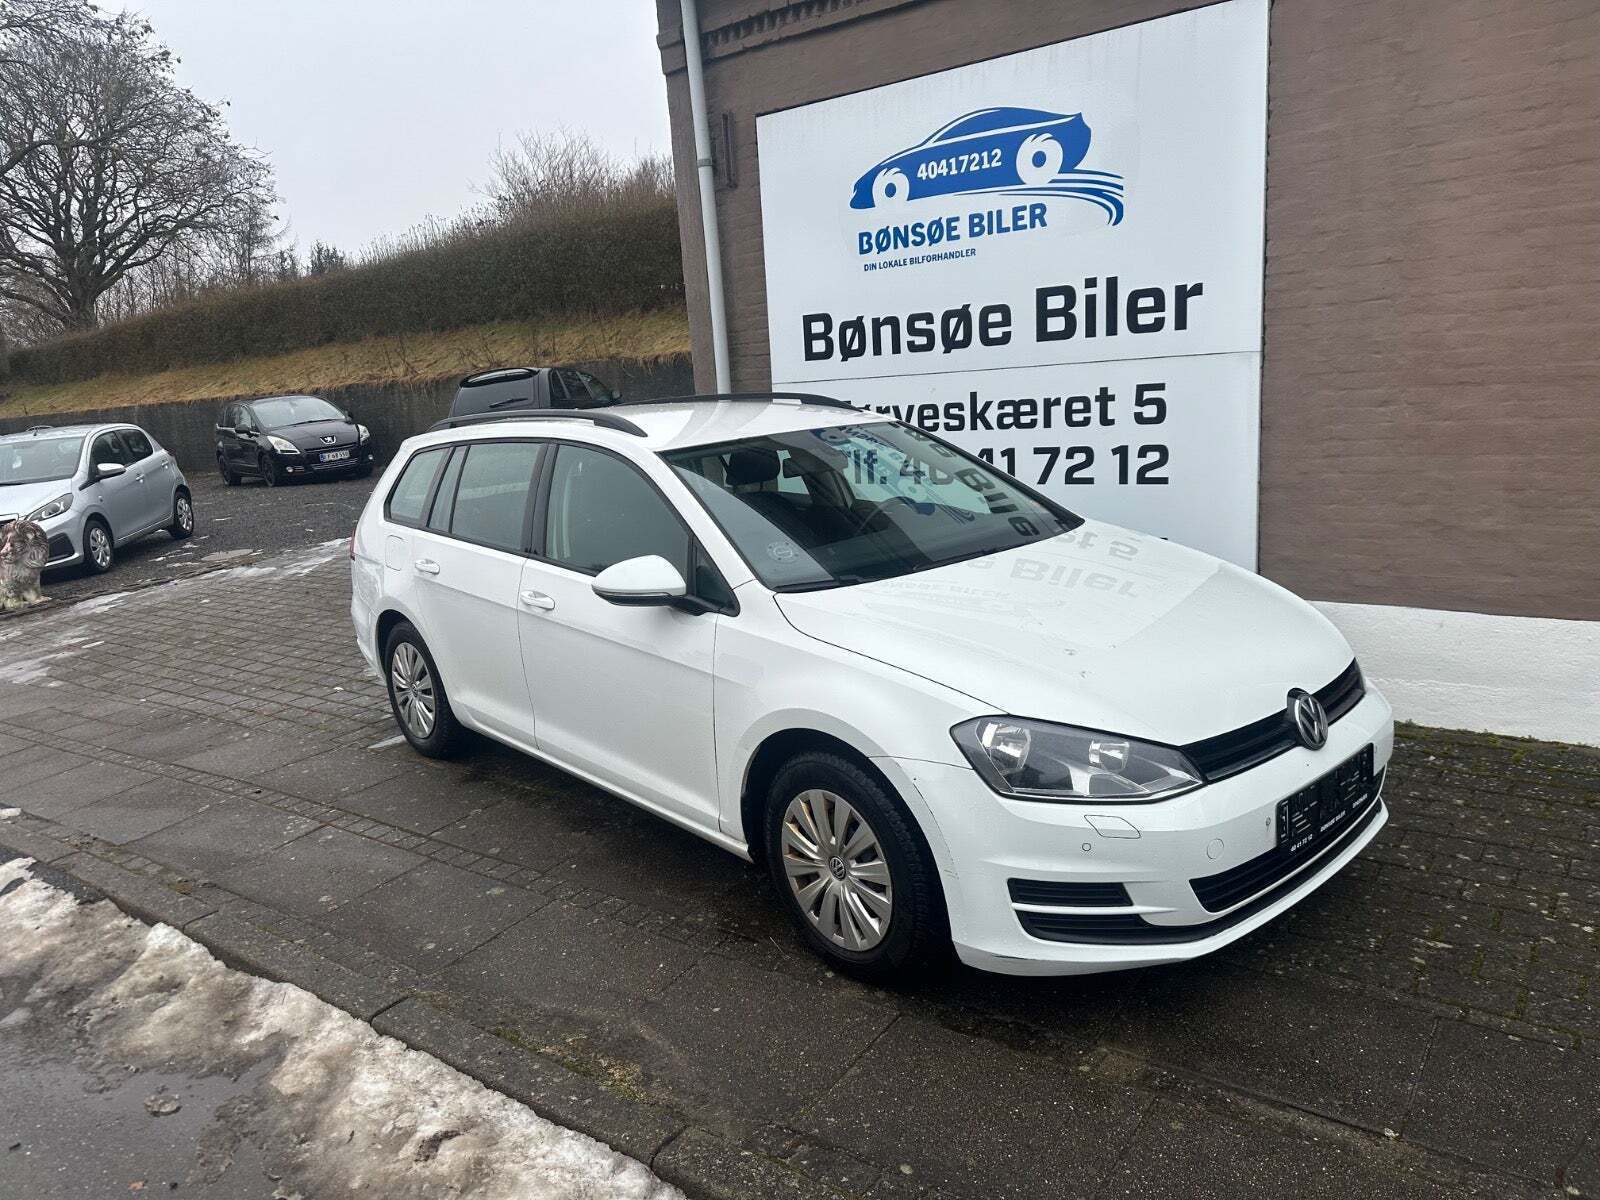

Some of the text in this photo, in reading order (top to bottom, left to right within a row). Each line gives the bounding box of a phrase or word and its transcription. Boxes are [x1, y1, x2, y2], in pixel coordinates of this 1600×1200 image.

[917, 148, 1002, 180] 40417212
[858, 202, 1047, 255] BØNSØE BILER
[864, 248, 976, 272] DIN LOKALE BILFORHANDLER
[802, 275, 1204, 362] Bønsøe Biler
[1134, 382, 1168, 426] 5
[845, 449, 887, 484] lf.
[1033, 446, 1095, 486] 72
[1111, 444, 1170, 486] 12
